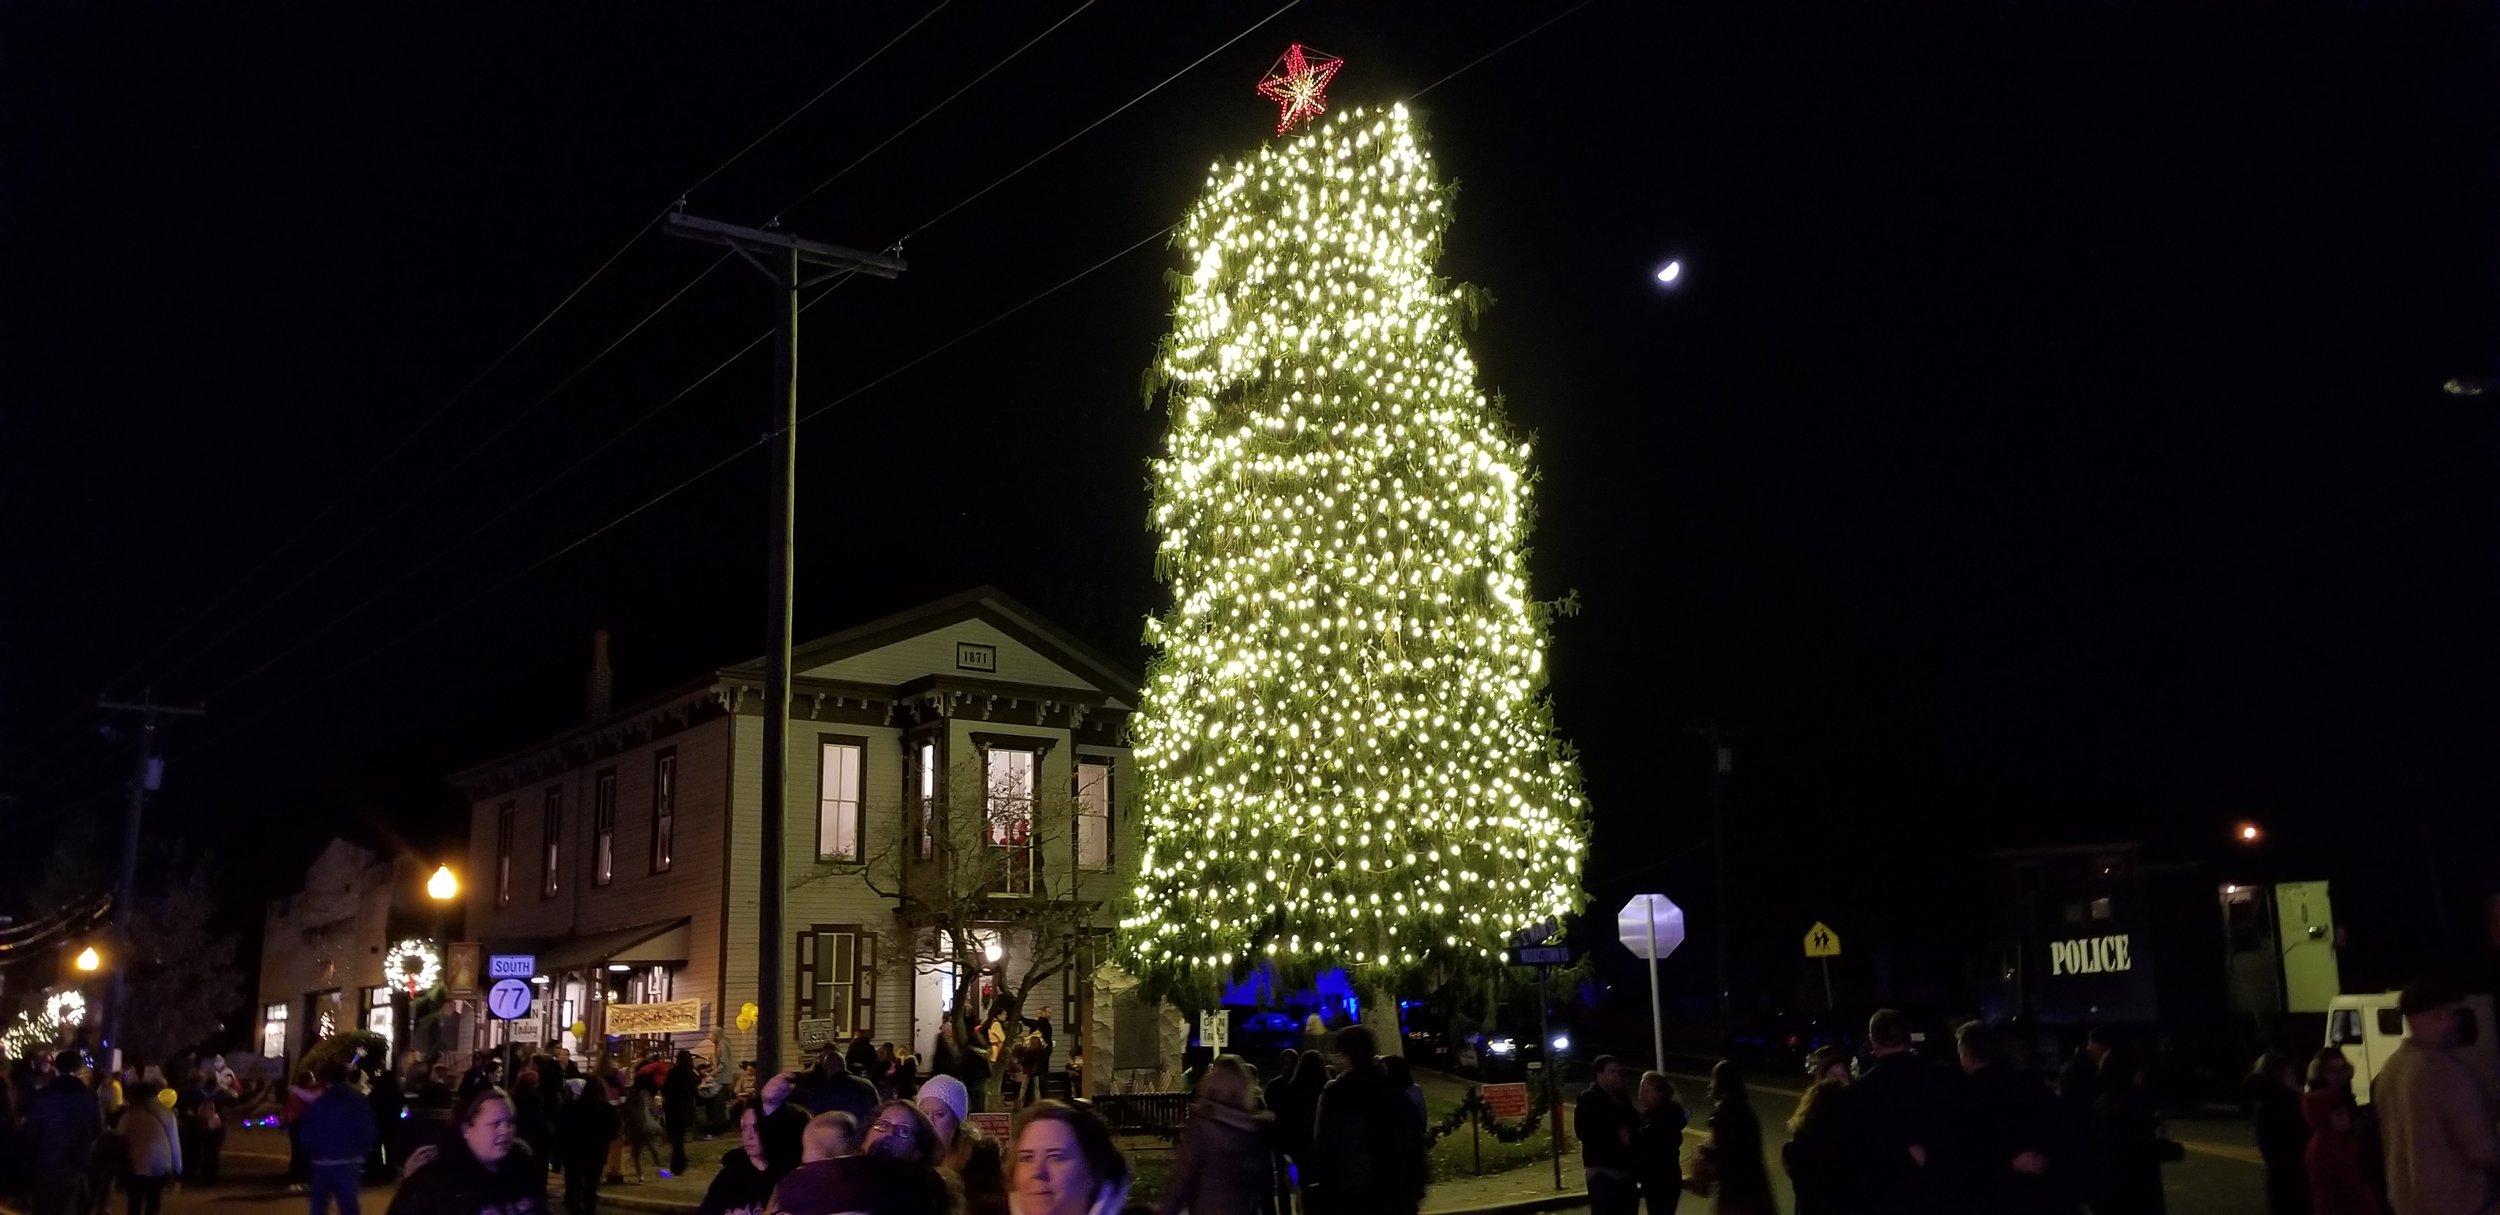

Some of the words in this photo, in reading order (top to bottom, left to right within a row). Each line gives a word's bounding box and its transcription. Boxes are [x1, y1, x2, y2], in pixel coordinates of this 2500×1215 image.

[964, 651, 987, 664] 1871
[2050, 934, 2131, 975] POLICE
[495, 961, 530, 973] SOUTH
[495, 987, 524, 1010] 77
[513, 1022, 538, 1037] Today
